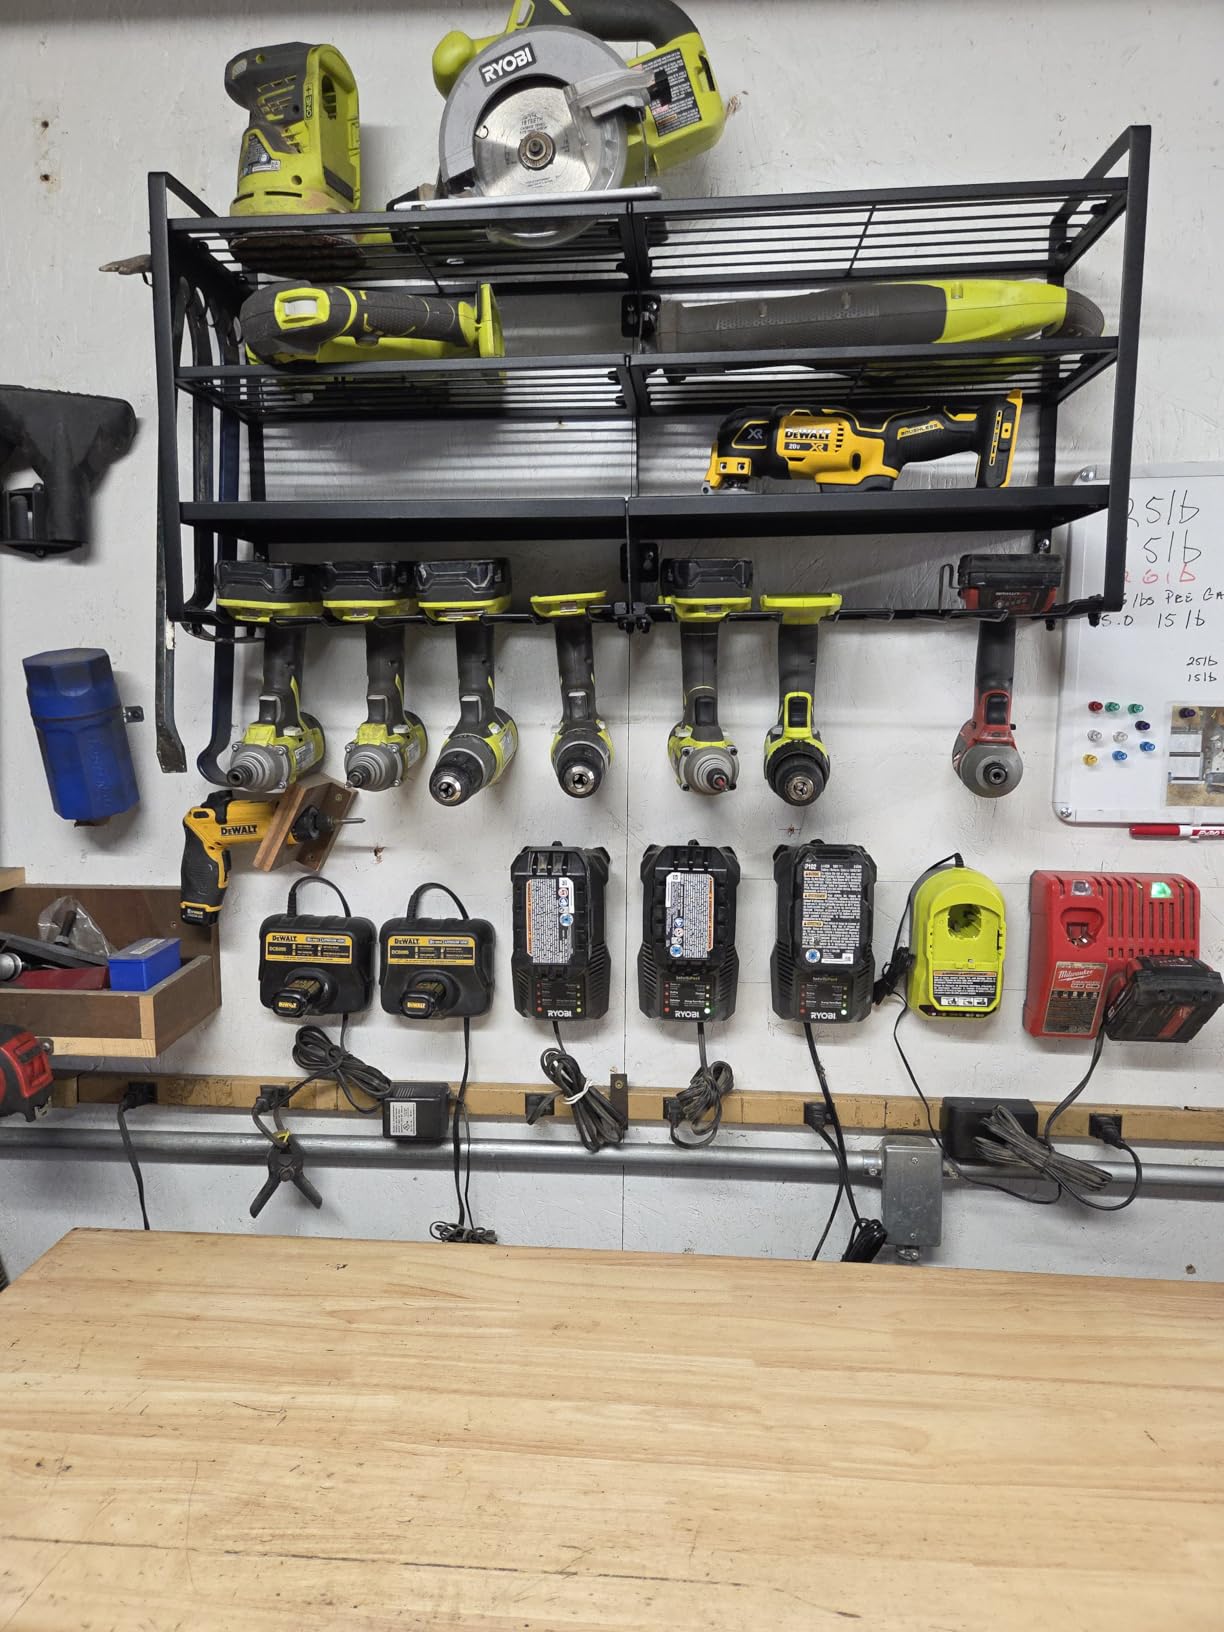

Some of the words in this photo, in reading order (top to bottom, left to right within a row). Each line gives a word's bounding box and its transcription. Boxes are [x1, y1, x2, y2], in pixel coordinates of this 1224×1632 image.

[481, 47, 532, 82] RYOBI
[784, 429, 832, 440] DEWALT
[1186, 655, 1219, 667] 25lb
[221, 824, 257, 835] DEWALT
[1058, 969, 1094, 979] Milwaukee
[675, 1010, 700, 1018] RYOBI
[810, 1011, 836, 1020] RYOBI
